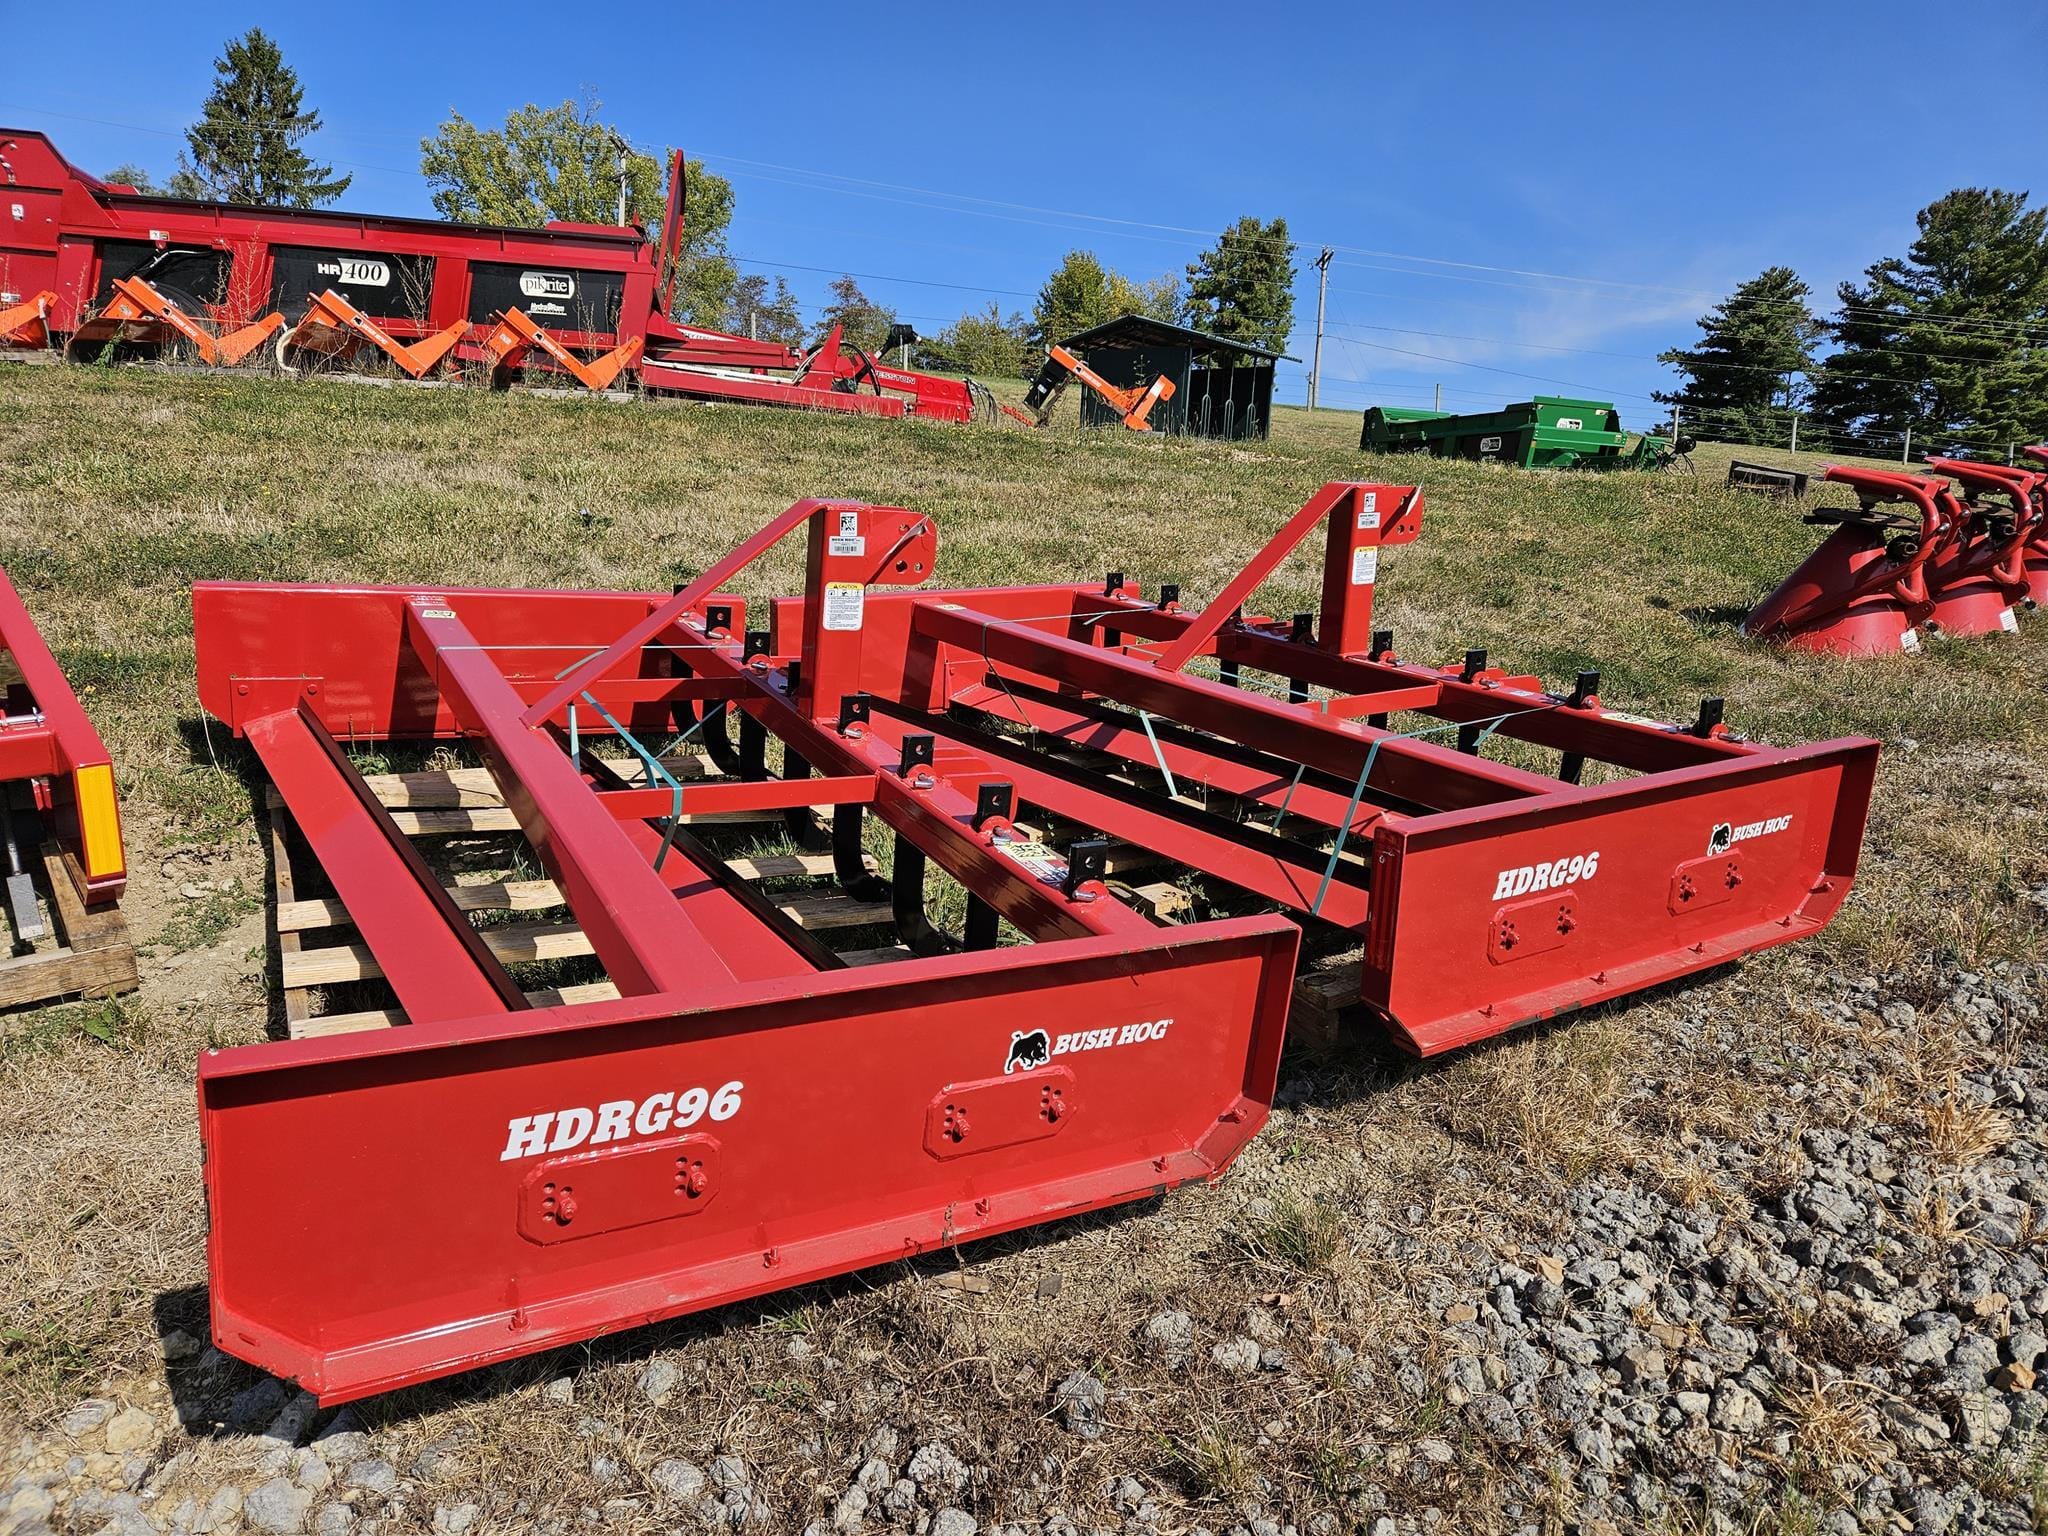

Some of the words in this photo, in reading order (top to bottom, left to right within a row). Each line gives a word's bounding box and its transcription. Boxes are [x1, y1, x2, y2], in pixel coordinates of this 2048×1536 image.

[318, 263, 340, 275] HR
[345, 264, 382, 281] 400
[525, 276, 568, 293] pikrite
[874, 370, 916, 385] ESSTON
[1731, 821, 1765, 843] BUSH
[1763, 814, 1793, 835] HOG
[1492, 851, 1600, 901] HDRG96
[1051, 1027, 1118, 1056] BUSH
[1116, 1019, 1169, 1046] HOG
[500, 1081, 744, 1162] HDRG96
